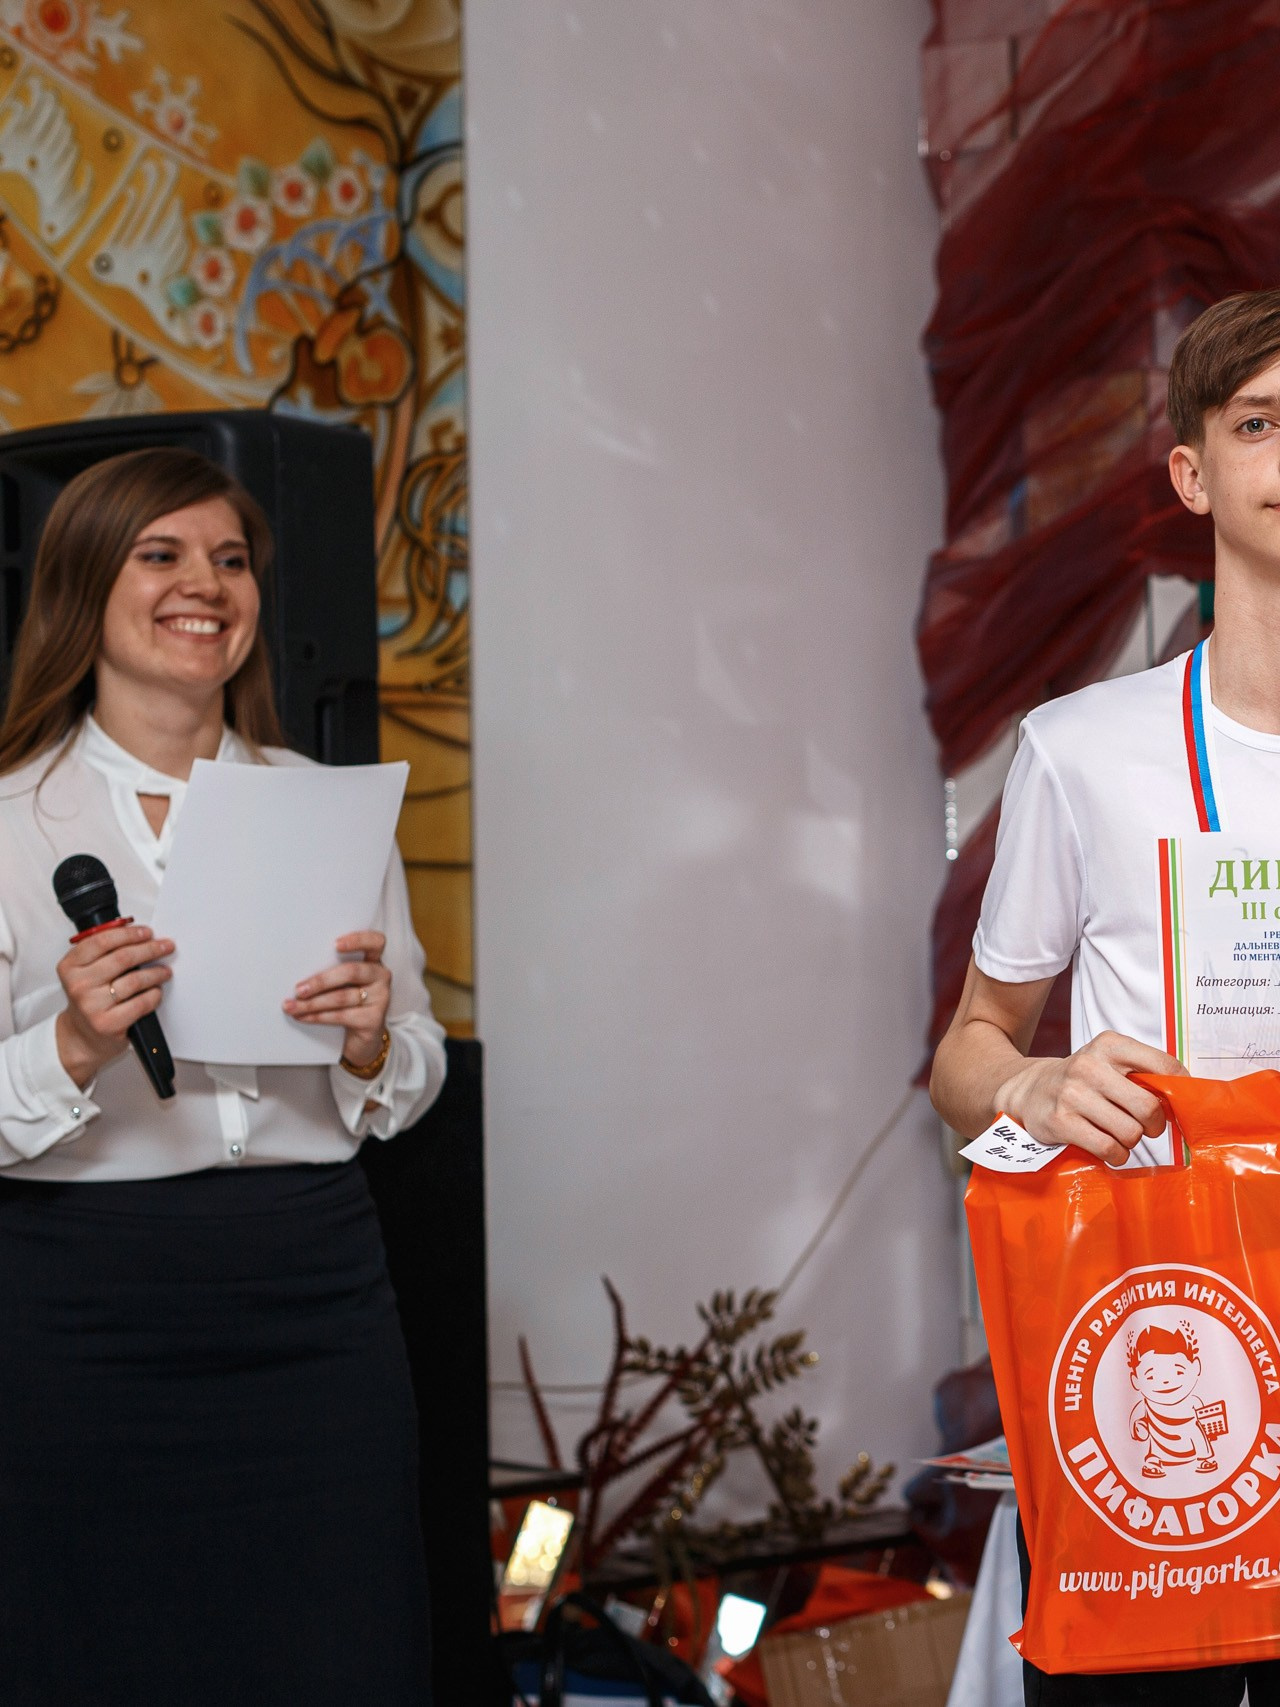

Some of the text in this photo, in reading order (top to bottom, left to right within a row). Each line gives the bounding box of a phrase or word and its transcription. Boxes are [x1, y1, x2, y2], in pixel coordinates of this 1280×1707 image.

[1241, 901, 1267, 920] III
[1233, 953, 1247, 962] ПО
[1195, 975, 1271, 990] Категория:
[1196, 1003, 1275, 1016] Номинация:
[1064, 1280, 1280, 1412] ЦЕНТР РАЗВИТИЯ ИНТЕЛЛЕКТА
